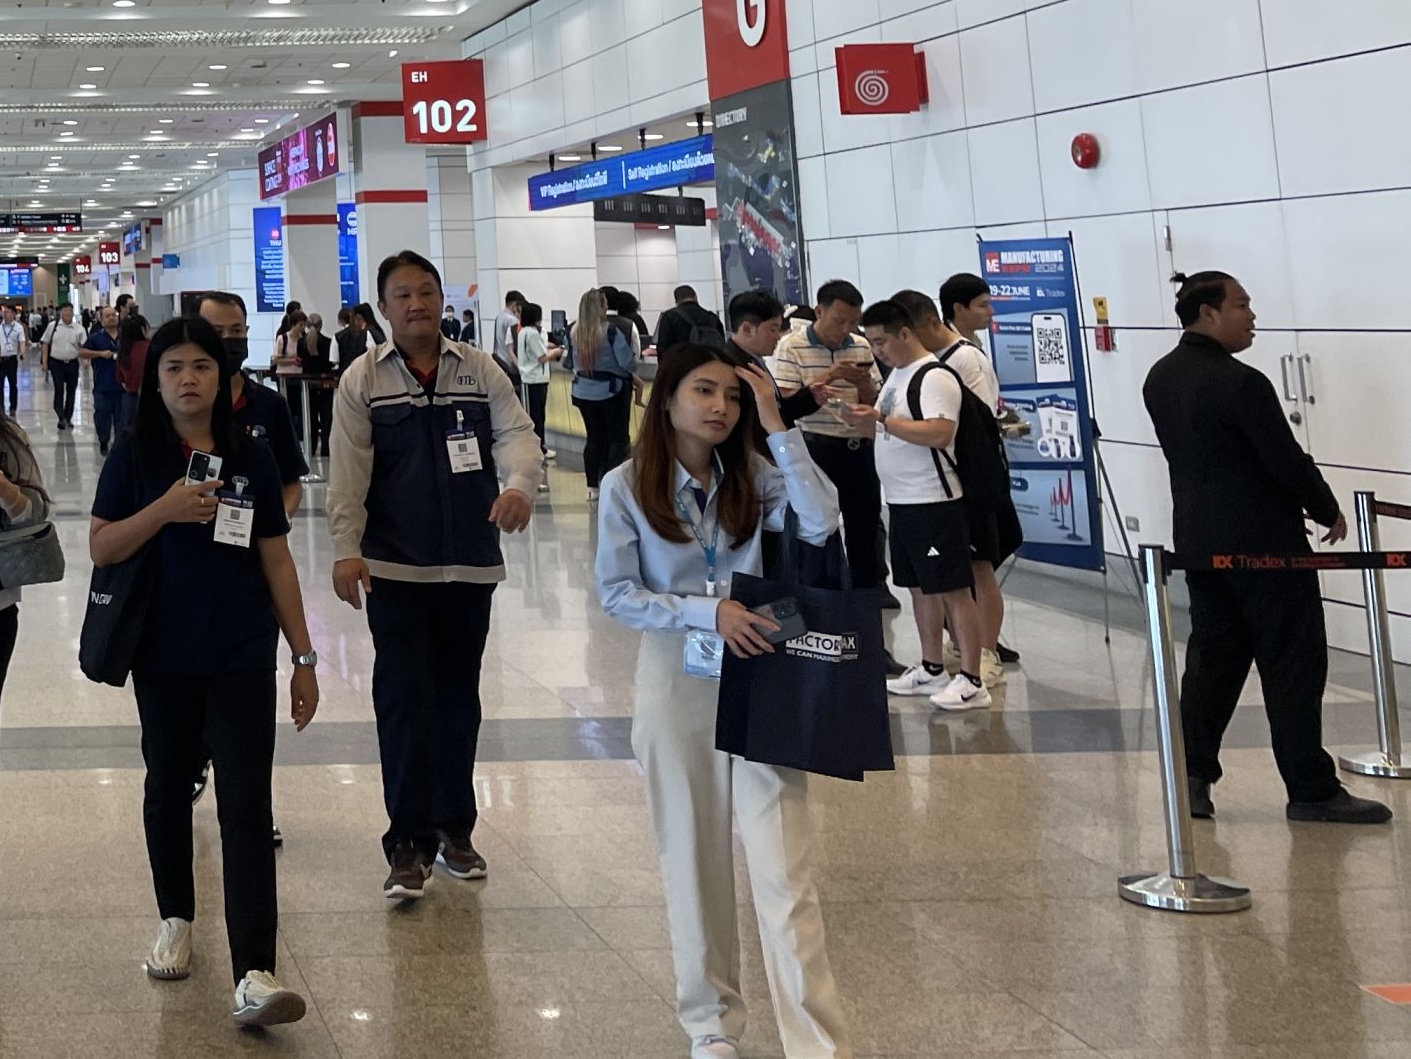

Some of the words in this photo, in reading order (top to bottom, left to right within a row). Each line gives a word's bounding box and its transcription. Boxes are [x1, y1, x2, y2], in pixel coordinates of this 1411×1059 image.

[411, 70, 427, 82] EH
[413, 99, 477, 134] 102
[716, 107, 747, 128] DIRECTORY
[101, 252, 118, 262] 103
[1001, 250, 1064, 264] MANUFACTURING
[76, 264, 89, 273] 104
[1002, 264, 1031, 273] EXPO
[1035, 263, 1064, 272] 2024
[989, 284, 1010, 296] 19-22
[1010, 286, 1030, 296] JUNE
[1237, 554, 1286, 569] Tradex
[797, 650, 812, 658] CAN
